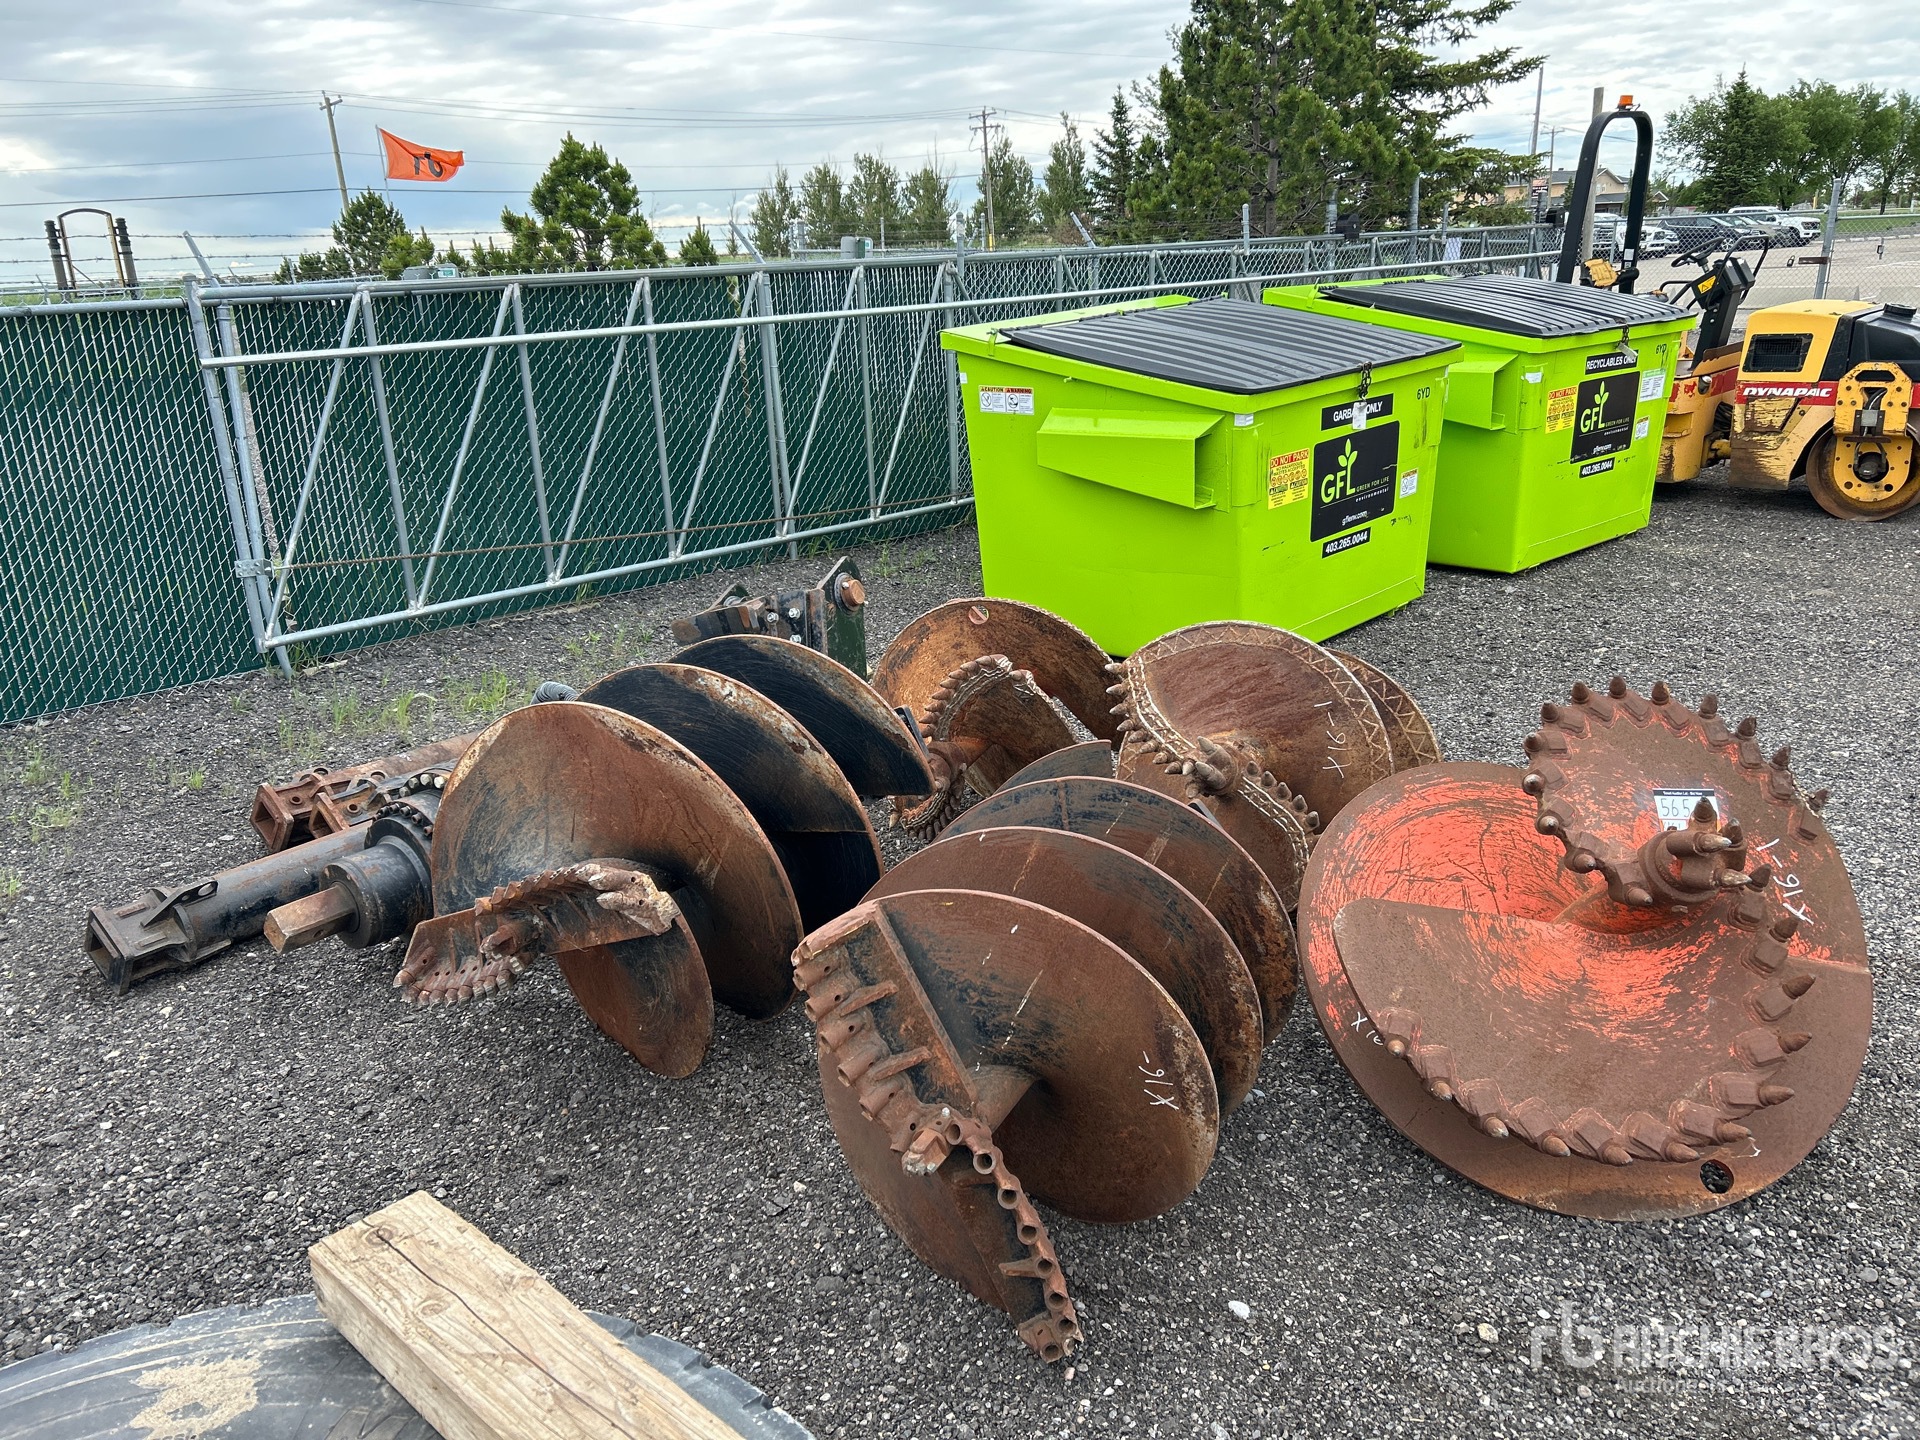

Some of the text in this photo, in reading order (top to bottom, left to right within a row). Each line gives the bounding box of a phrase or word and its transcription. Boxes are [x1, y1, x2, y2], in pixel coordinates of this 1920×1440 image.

[1656, 344, 1667, 354] 6YD
[1586, 356, 1623, 370] RECYCLABLES
[1416, 387, 1431, 400] 6YD
[1743, 387, 1832, 397] DYNAPAC
[1366, 401, 1383, 415] ONLY
[1580, 394, 1605, 433] GFL
[1271, 449, 1309, 468] DO NOT PARK
[1321, 453, 1356, 503] GFL
[1356, 476, 1390, 492] GREEN FOR LIFE
[1325, 531, 1368, 554] 403.265.0044
